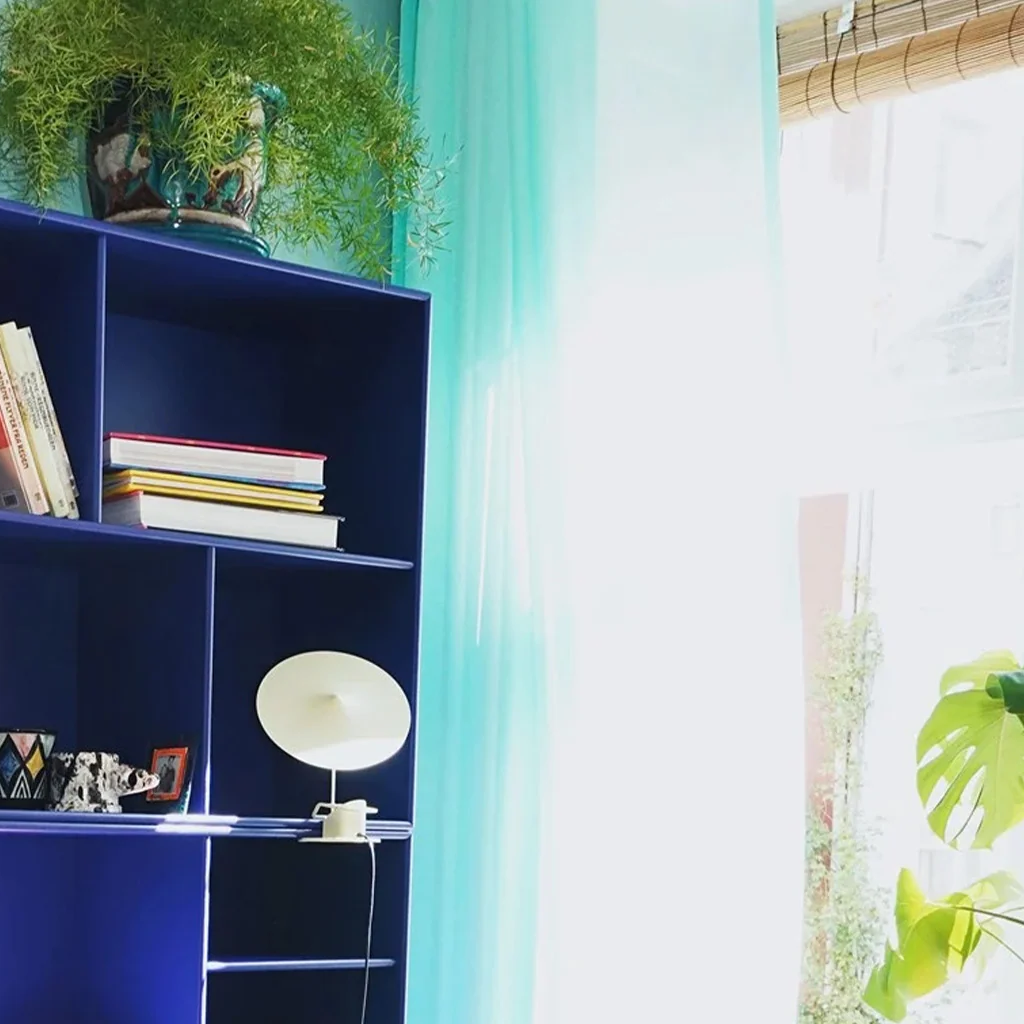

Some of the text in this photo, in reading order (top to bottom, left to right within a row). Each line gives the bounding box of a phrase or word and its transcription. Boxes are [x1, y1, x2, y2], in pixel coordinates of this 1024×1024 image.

[4, 398, 16, 425] FLYVER
[12, 425, 20, 439] FRA
[16, 439, 29, 470] REDEN
